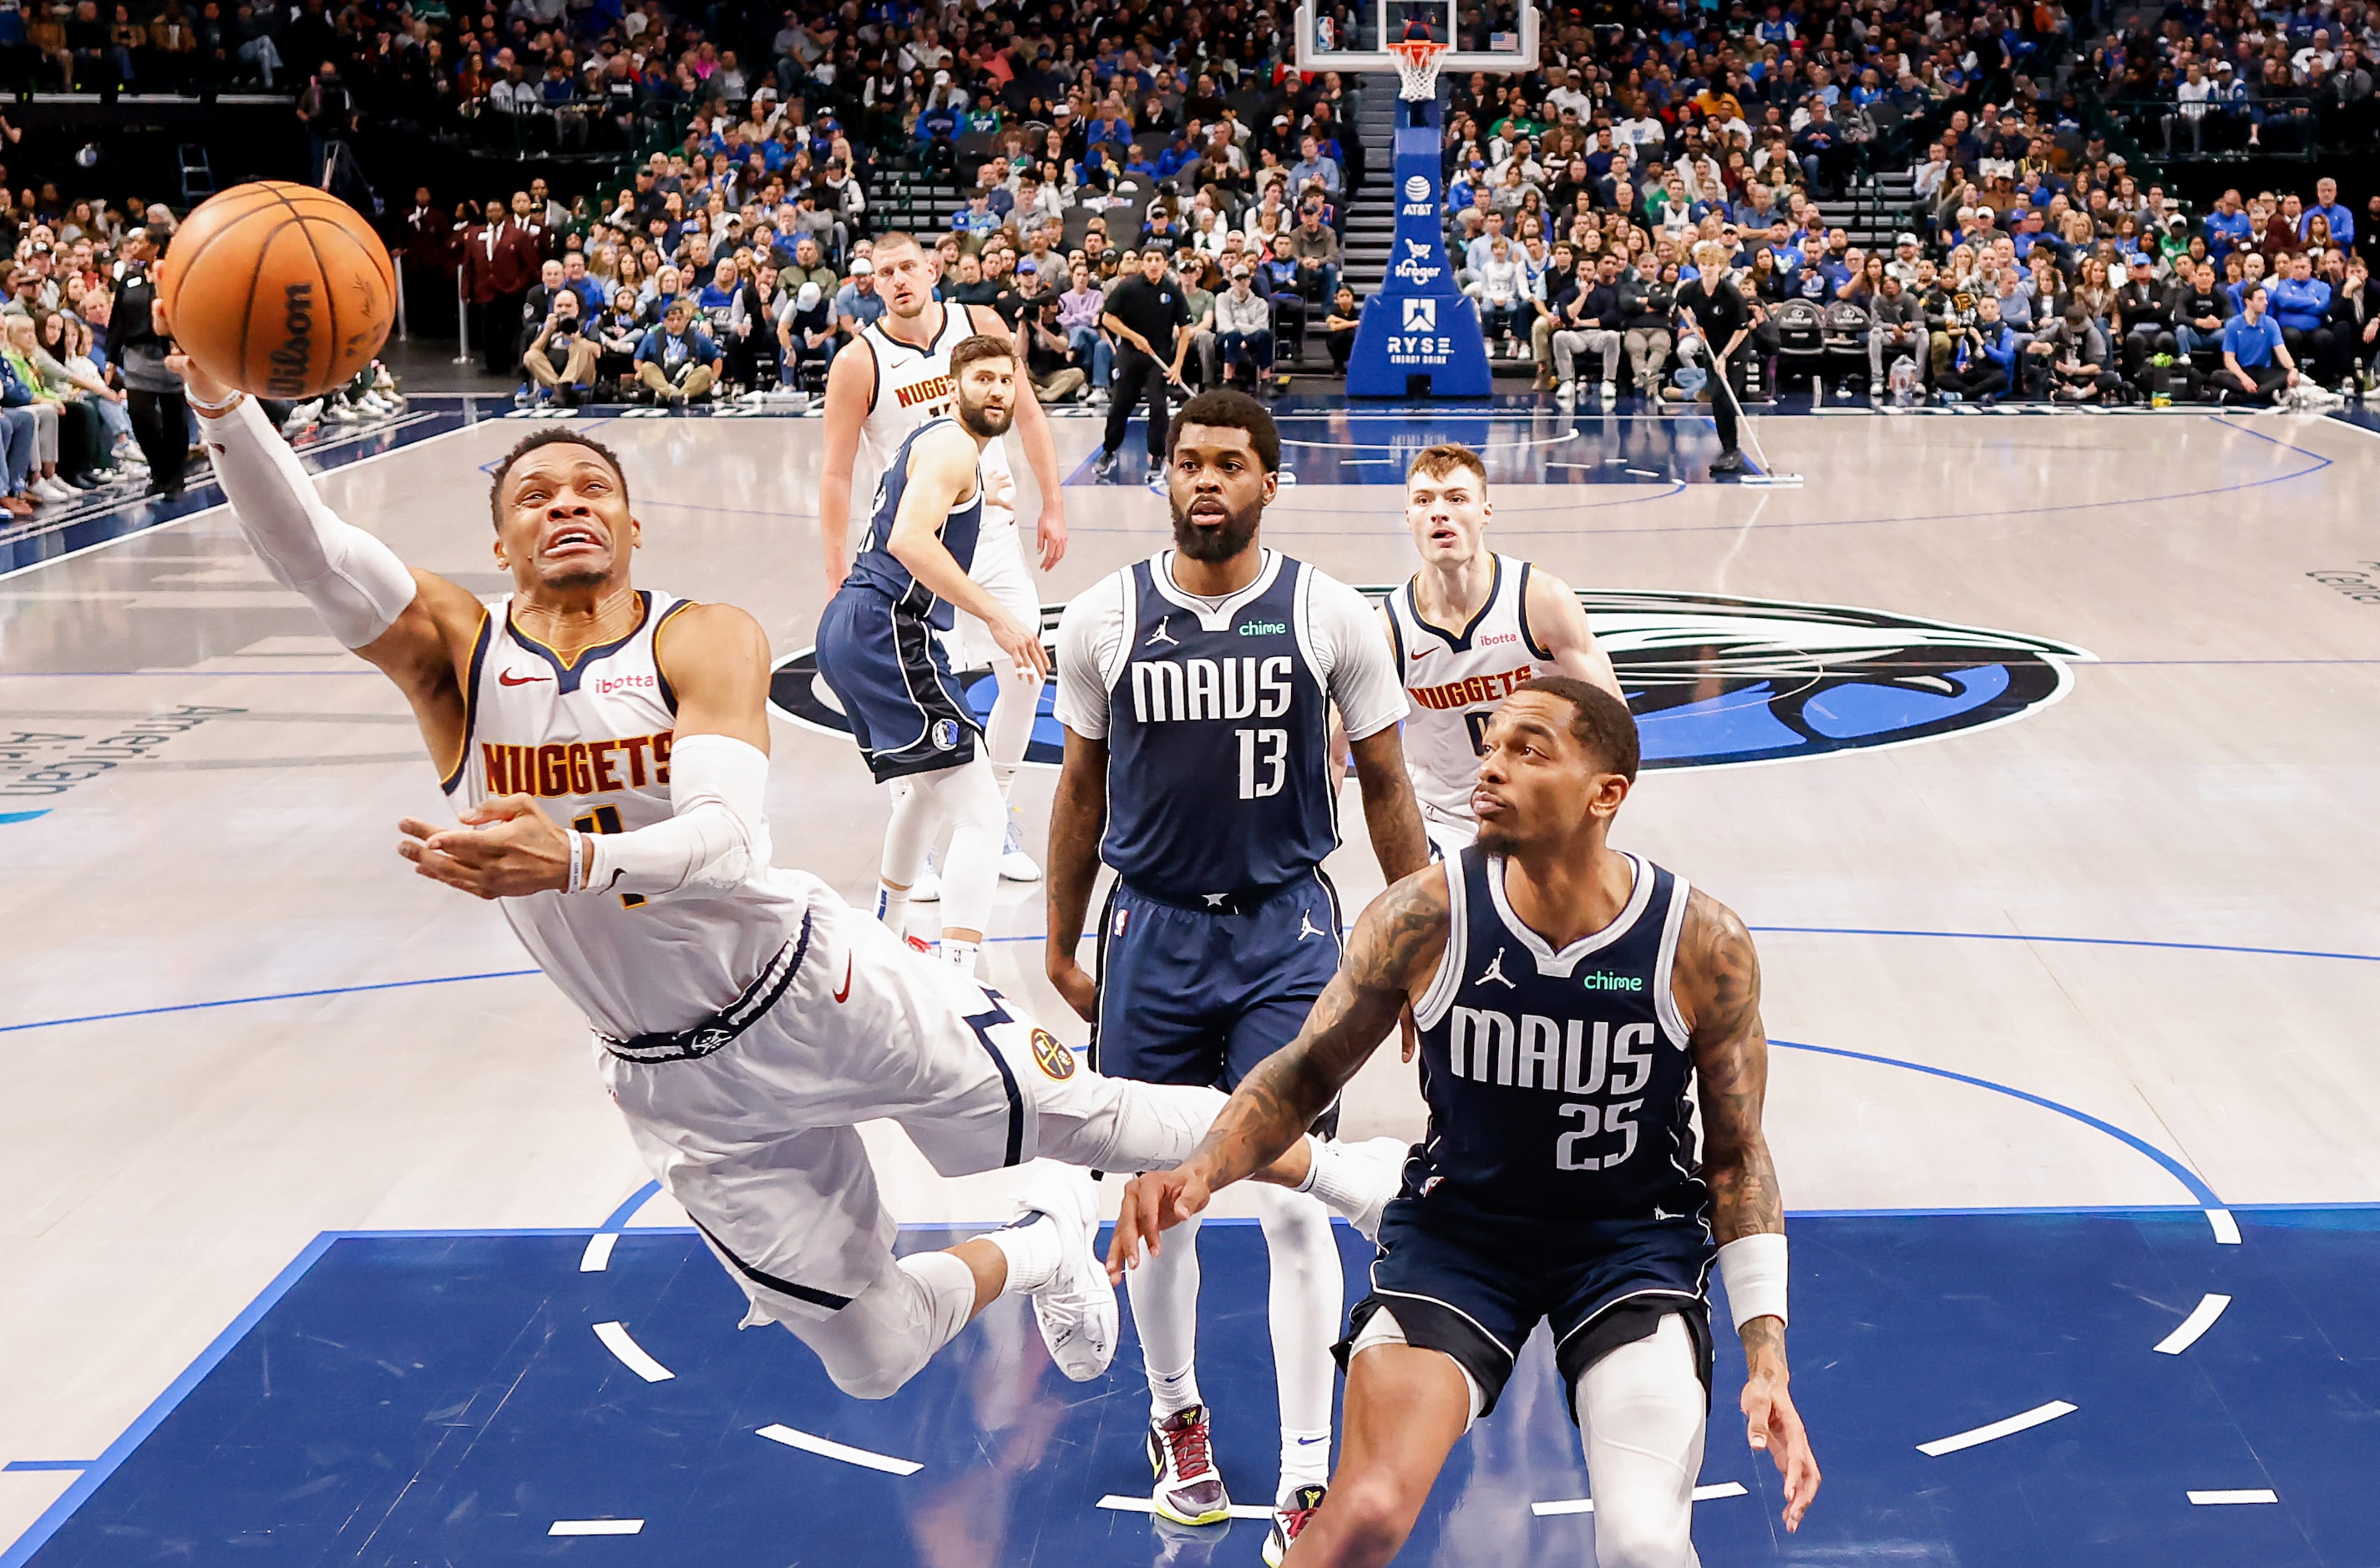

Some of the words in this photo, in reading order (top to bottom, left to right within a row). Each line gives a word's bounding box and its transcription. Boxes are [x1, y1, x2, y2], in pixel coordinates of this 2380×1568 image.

[1402, 204, 1434, 216] AT&T
[1395, 258, 1441, 286] Kroger
[266, 281, 313, 399] Wilson
[1387, 336, 1451, 354] RYSE
[894, 375, 950, 408] NUGG
[1238, 620, 1287, 637] chime
[1480, 633, 1517, 647] ibotta
[595, 675, 655, 694] ibotta
[1132, 656, 1293, 723] MAVS
[481, 731, 674, 799] NUGGETS
[1234, 728, 1288, 800] 13
[1583, 970, 1643, 991] chime
[1450, 1005, 1655, 1095] MAVS
[1557, 1098, 1643, 1171] 25
